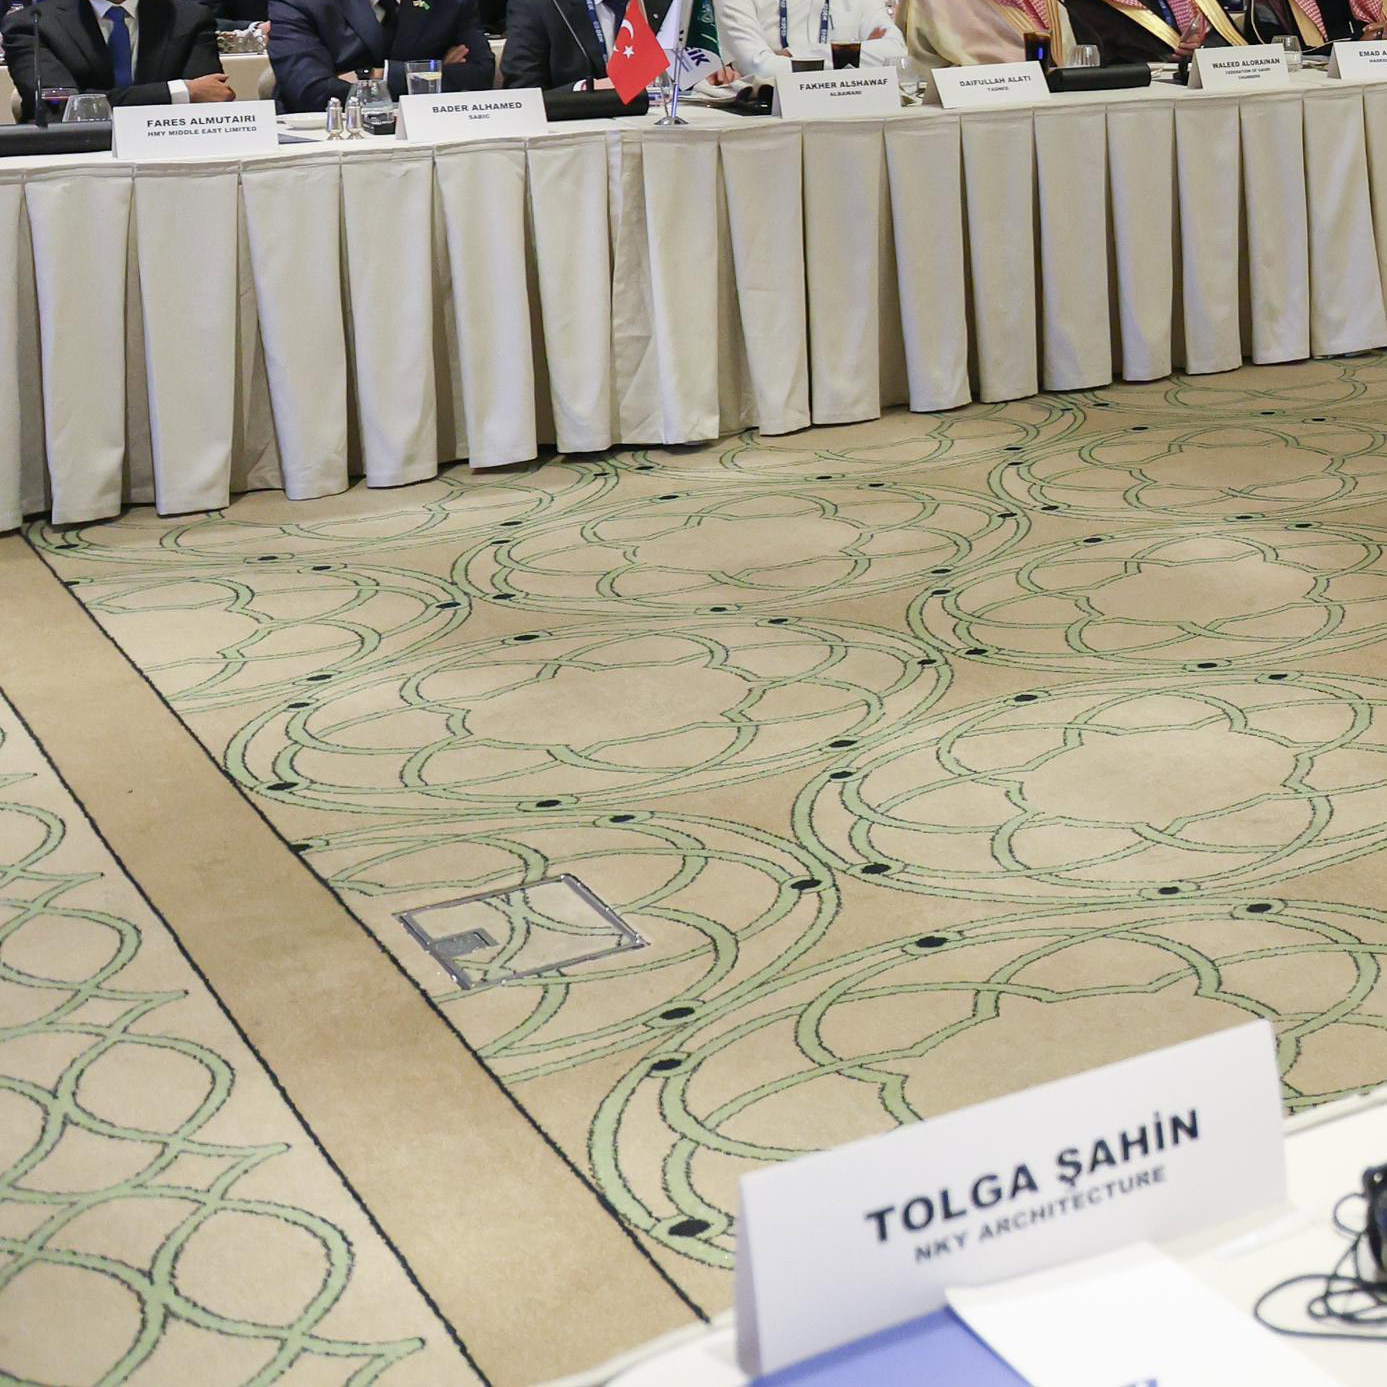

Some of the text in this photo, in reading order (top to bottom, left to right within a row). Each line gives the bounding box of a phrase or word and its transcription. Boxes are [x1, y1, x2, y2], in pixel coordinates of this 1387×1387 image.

[1212, 61, 1240, 69] WALEED
[800, 78, 888, 91] FAKHER ALSHAWAF
[960, 75, 1032, 87] DAIFULLAH ALATI
[432, 101, 522, 114] BADER ALHAMED
[147, 115, 256, 128] FARES ALMUTAIRI
[468, 113, 490, 121] SABIC
[864, 1108, 1200, 1243] TOLGA ŞAHİN
[914, 1165, 1167, 1264] NKY ARCHITECTURE
